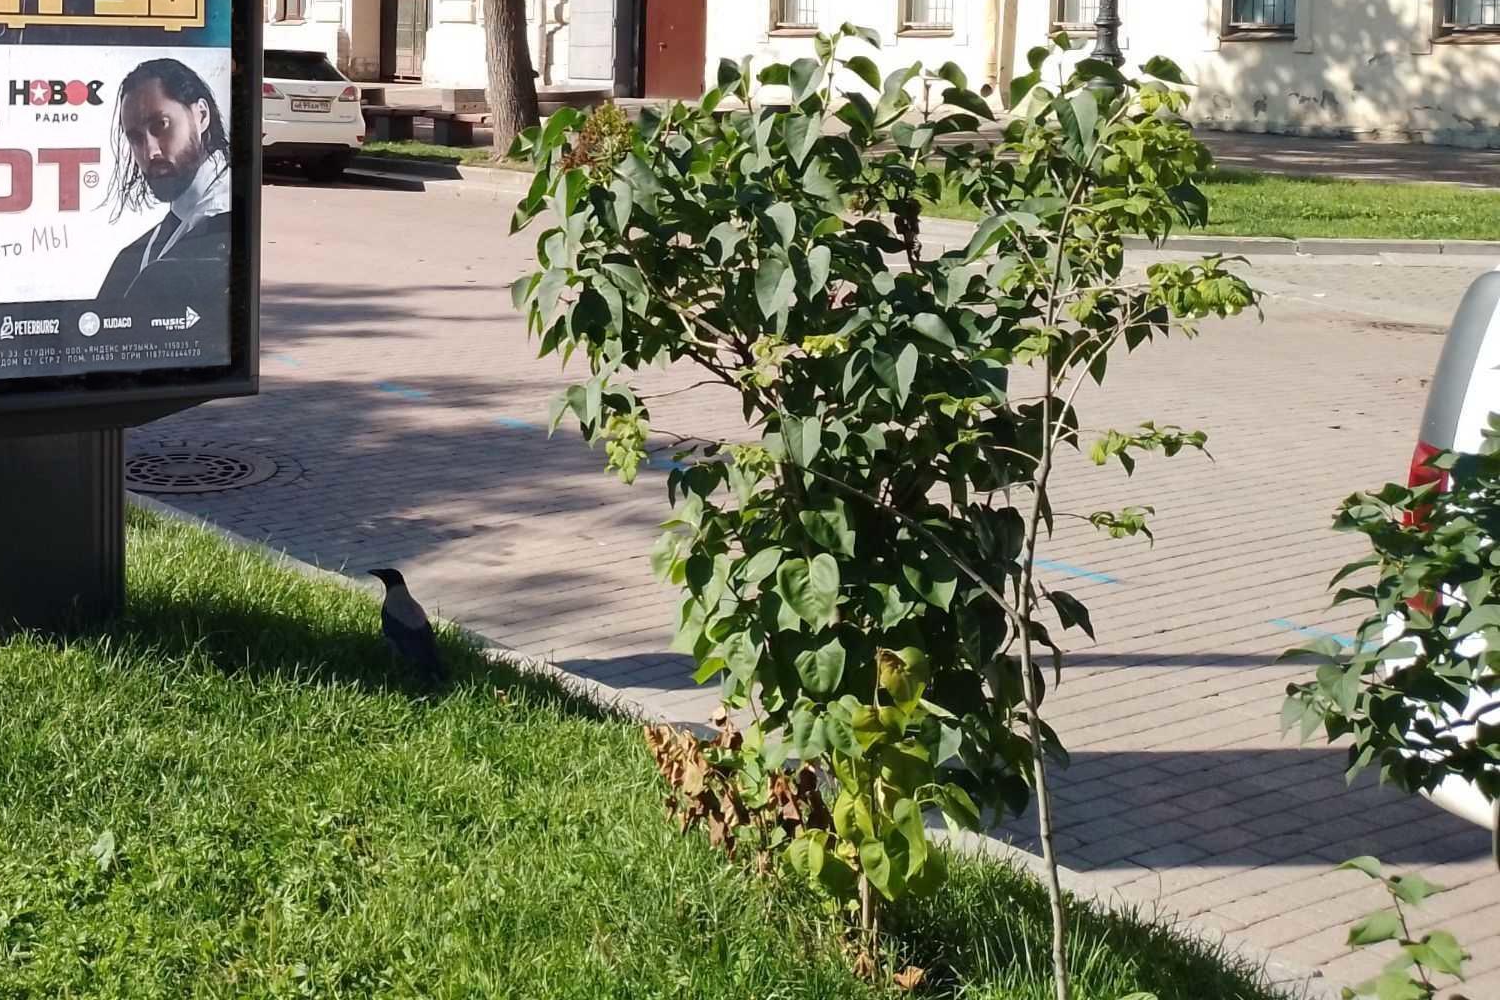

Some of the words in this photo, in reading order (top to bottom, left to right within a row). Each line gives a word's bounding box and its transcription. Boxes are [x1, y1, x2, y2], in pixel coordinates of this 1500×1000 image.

[35, 113, 79, 124] РАДИО
[86, 174, 97, 184] 23
[31, 224, 69, 252] МЫ
